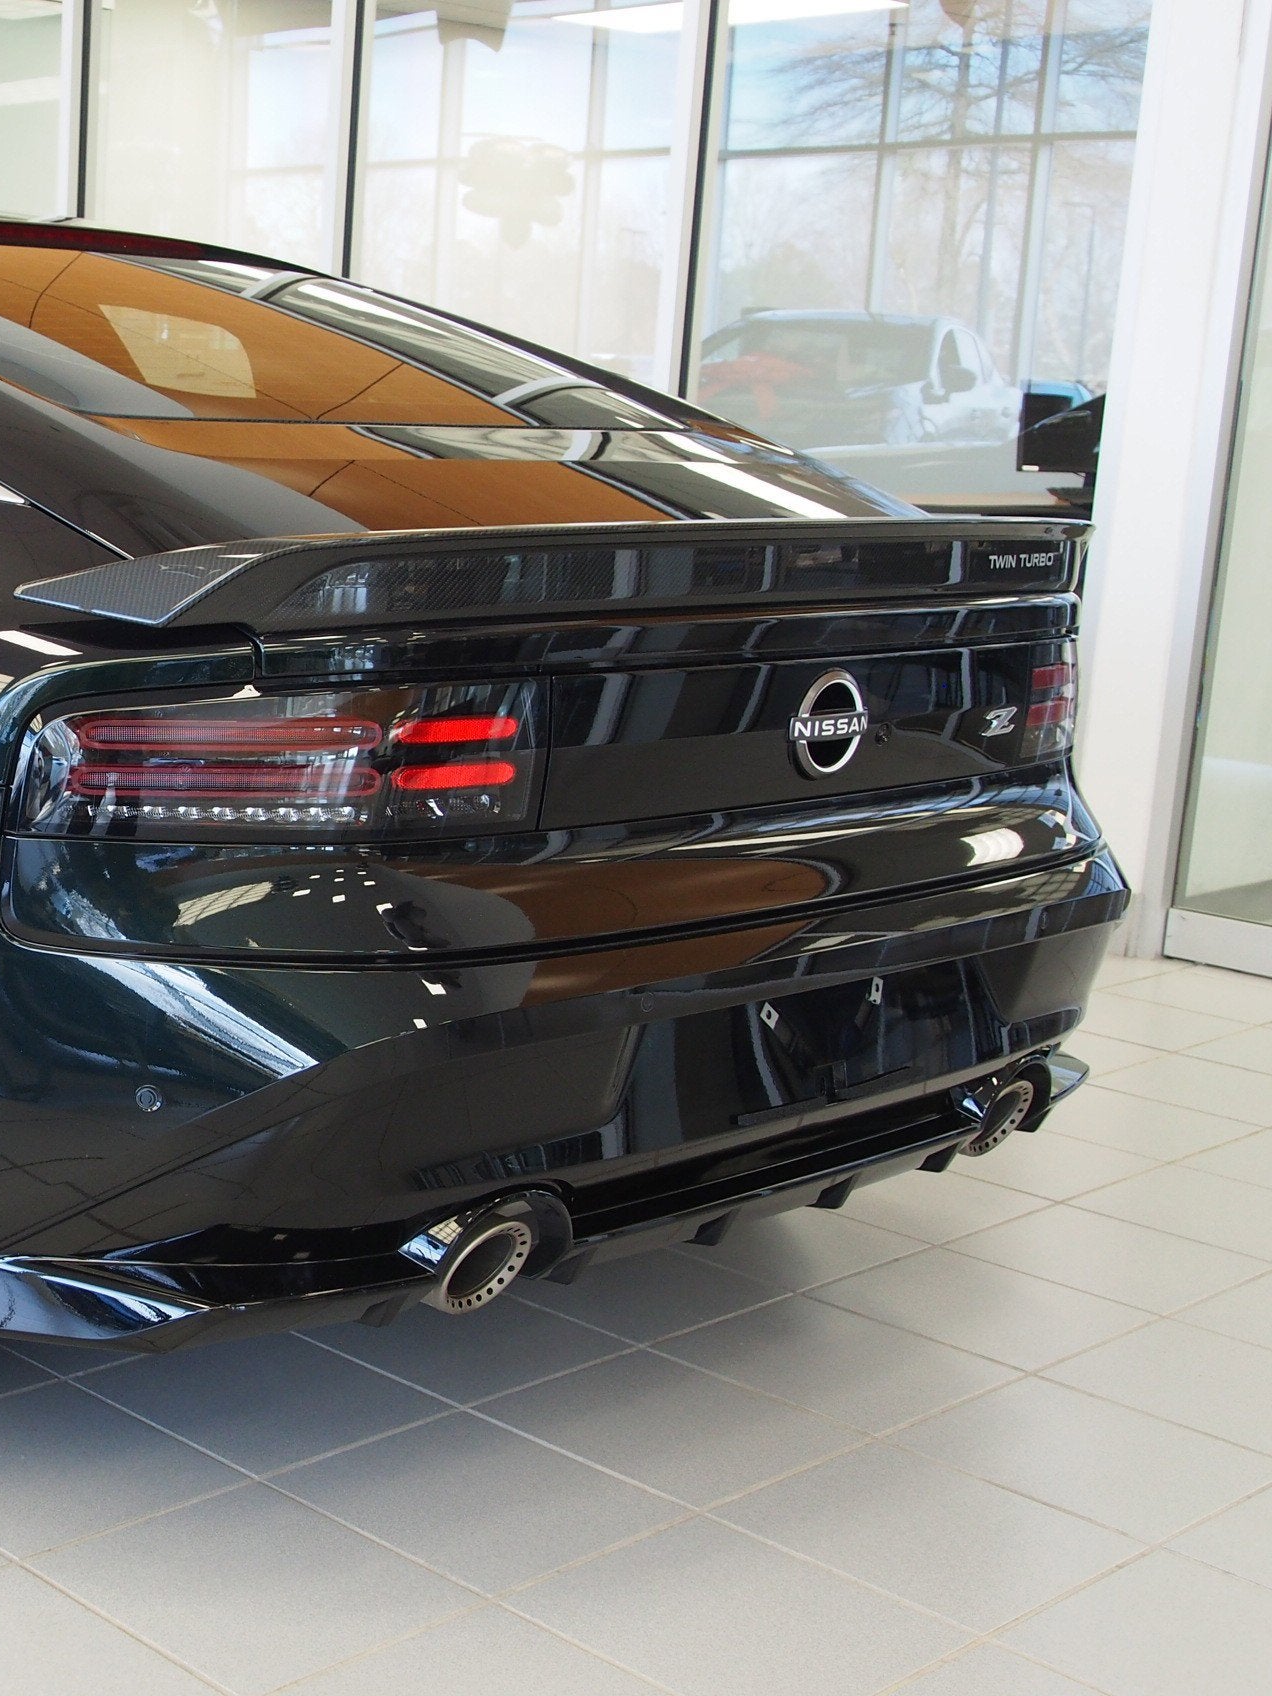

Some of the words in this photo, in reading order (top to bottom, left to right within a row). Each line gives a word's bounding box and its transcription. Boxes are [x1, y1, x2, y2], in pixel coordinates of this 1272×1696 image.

[989, 555, 1017, 569] TWIN
[1020, 553, 1054, 567] TURBO
[794, 715, 867, 737] NISSAN
[981, 706, 1018, 737] Z
